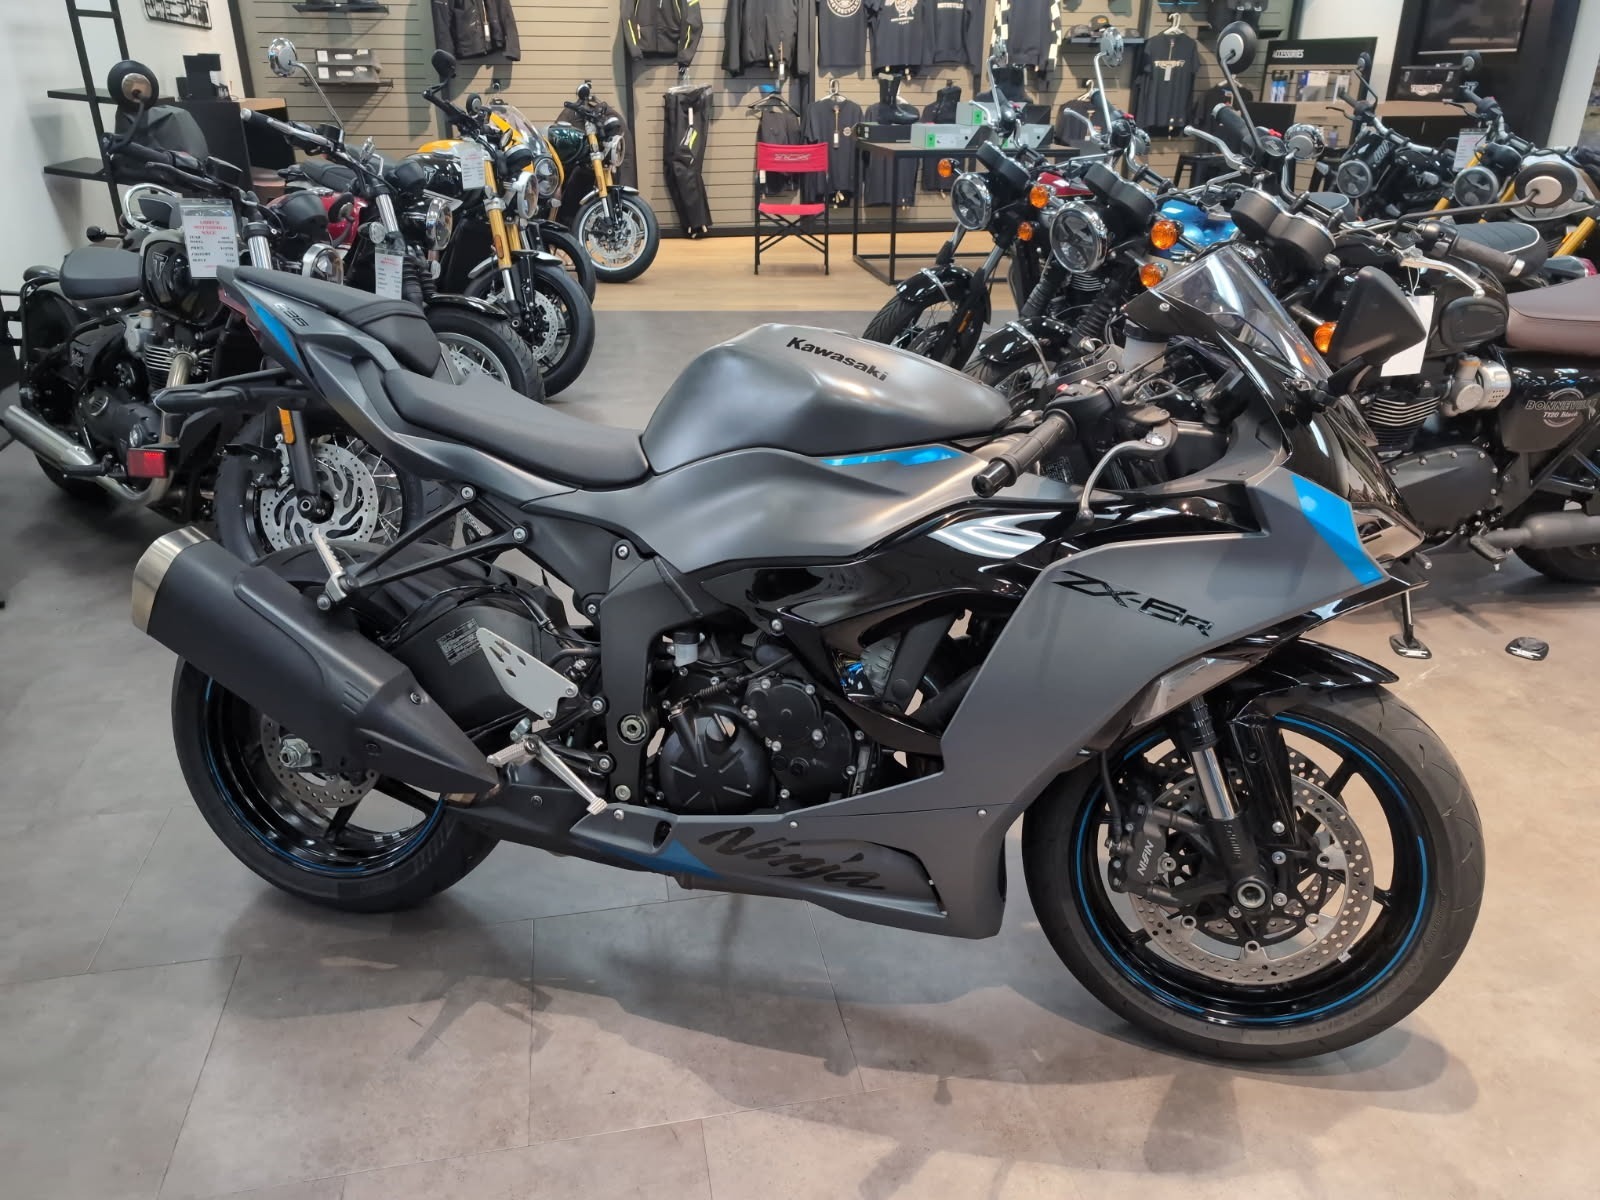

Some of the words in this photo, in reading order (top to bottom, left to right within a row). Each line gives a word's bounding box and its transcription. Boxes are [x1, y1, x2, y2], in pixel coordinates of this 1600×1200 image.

[786, 337, 888, 381] Kawasaki
[1051, 570, 1214, 637] ZX-6R
[698, 826, 886, 890] Ninja
